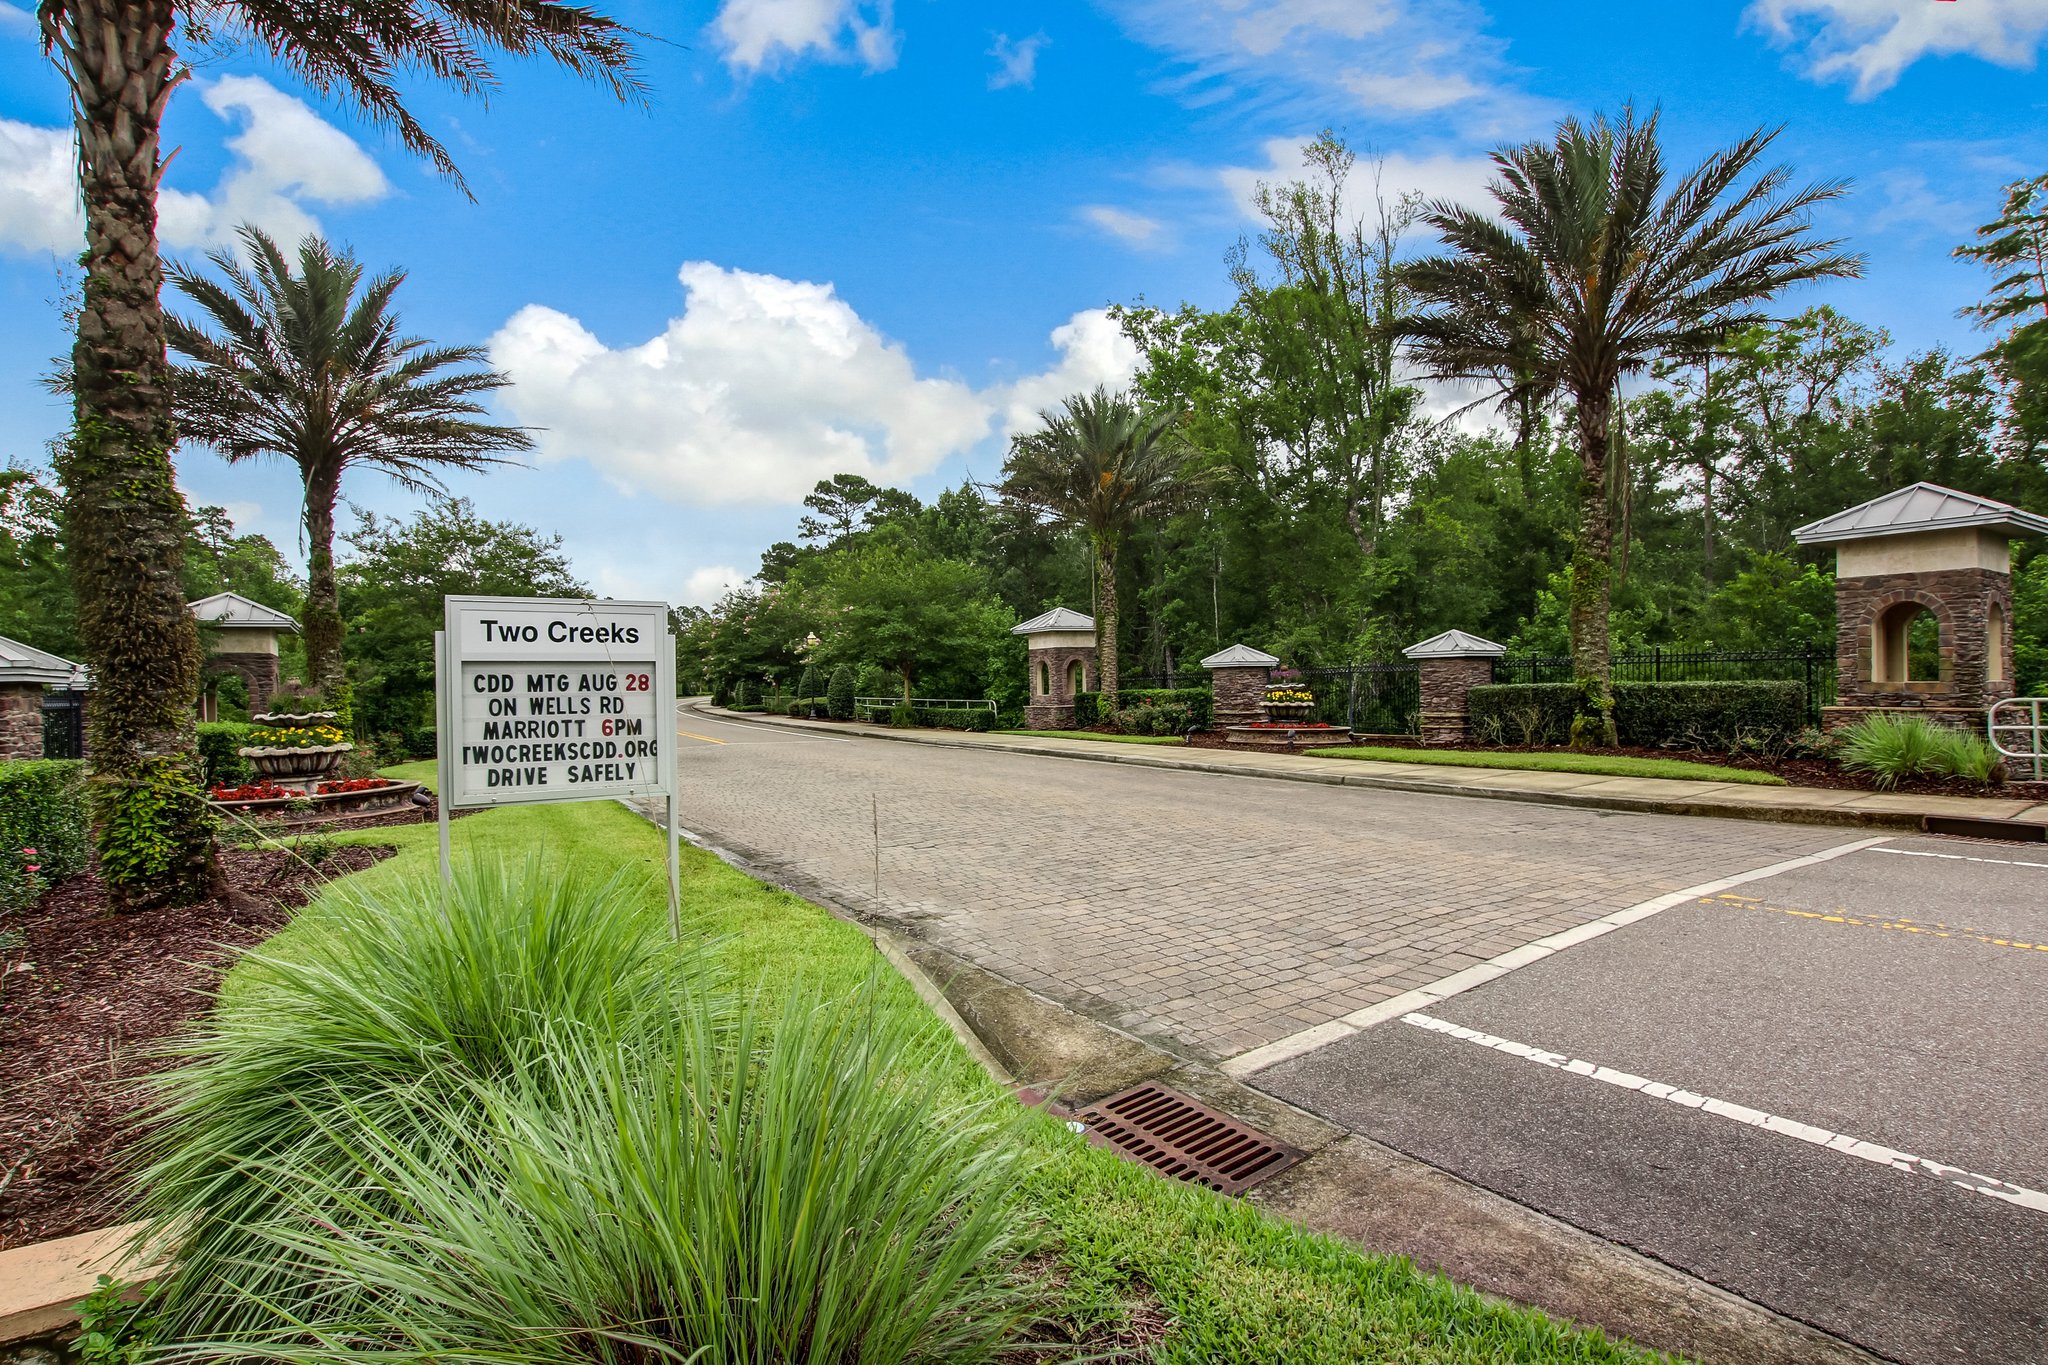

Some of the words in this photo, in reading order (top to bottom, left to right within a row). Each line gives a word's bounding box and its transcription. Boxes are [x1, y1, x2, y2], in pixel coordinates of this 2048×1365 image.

[480, 619, 538, 643] Two
[547, 620, 640, 644] Creeks
[473, 674, 514, 693] CDD
[527, 674, 570, 693] MTG
[578, 673, 617, 692] AUG
[625, 673, 650, 692] 28
[488, 698, 517, 716] ON
[529, 697, 591, 715] WELLS
[599, 696, 624, 714] RD
[483, 719, 586, 740] MARRIOTT
[601, 718, 642, 737] 6PM
[487, 766, 548, 787] DRIVE
[567, 762, 636, 783] SAFELY
